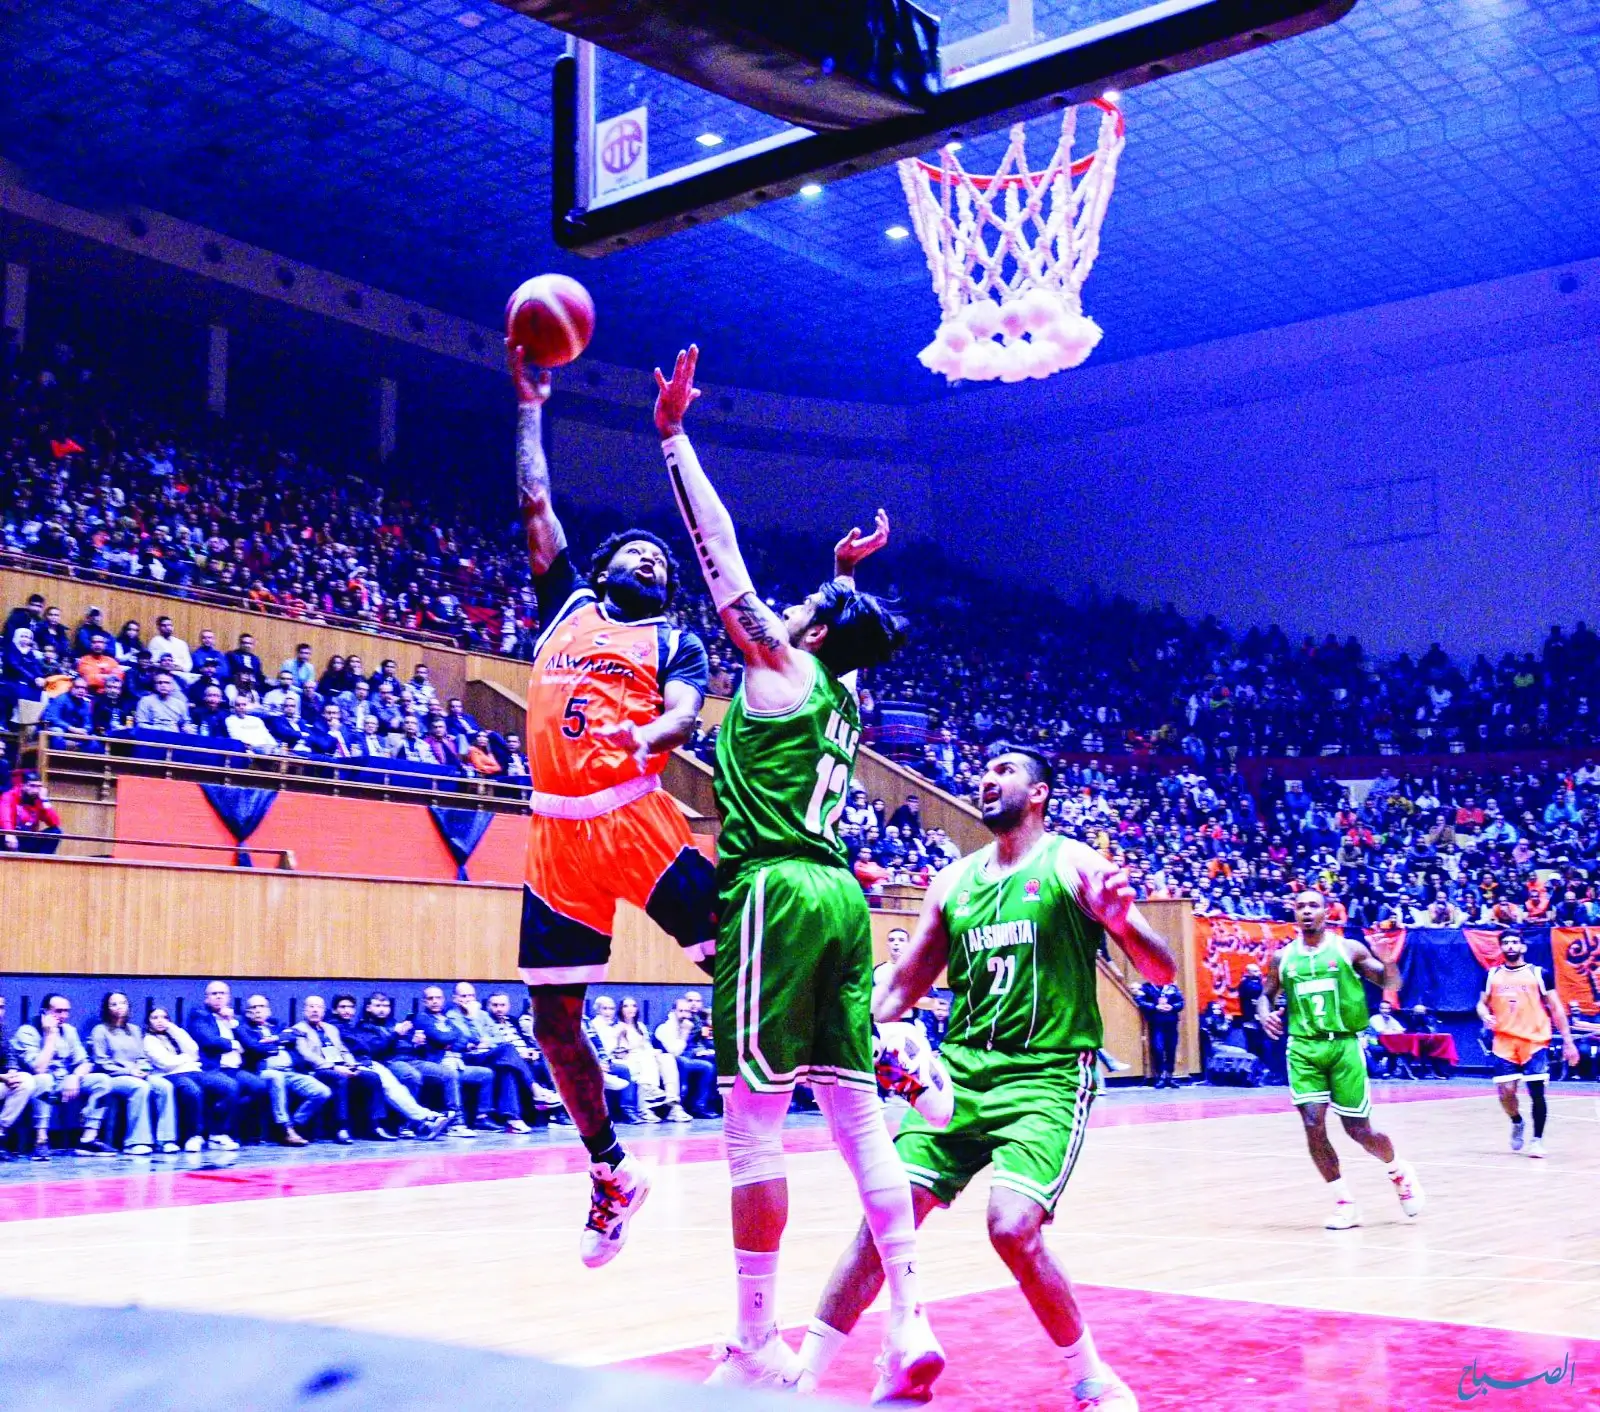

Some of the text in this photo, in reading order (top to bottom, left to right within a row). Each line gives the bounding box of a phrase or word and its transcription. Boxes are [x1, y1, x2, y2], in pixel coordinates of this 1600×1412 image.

[562, 697, 588, 739] 5
[805, 752, 848, 848] 12
[986, 955, 1016, 995] 21
[1311, 994, 1327, 1016] 2
